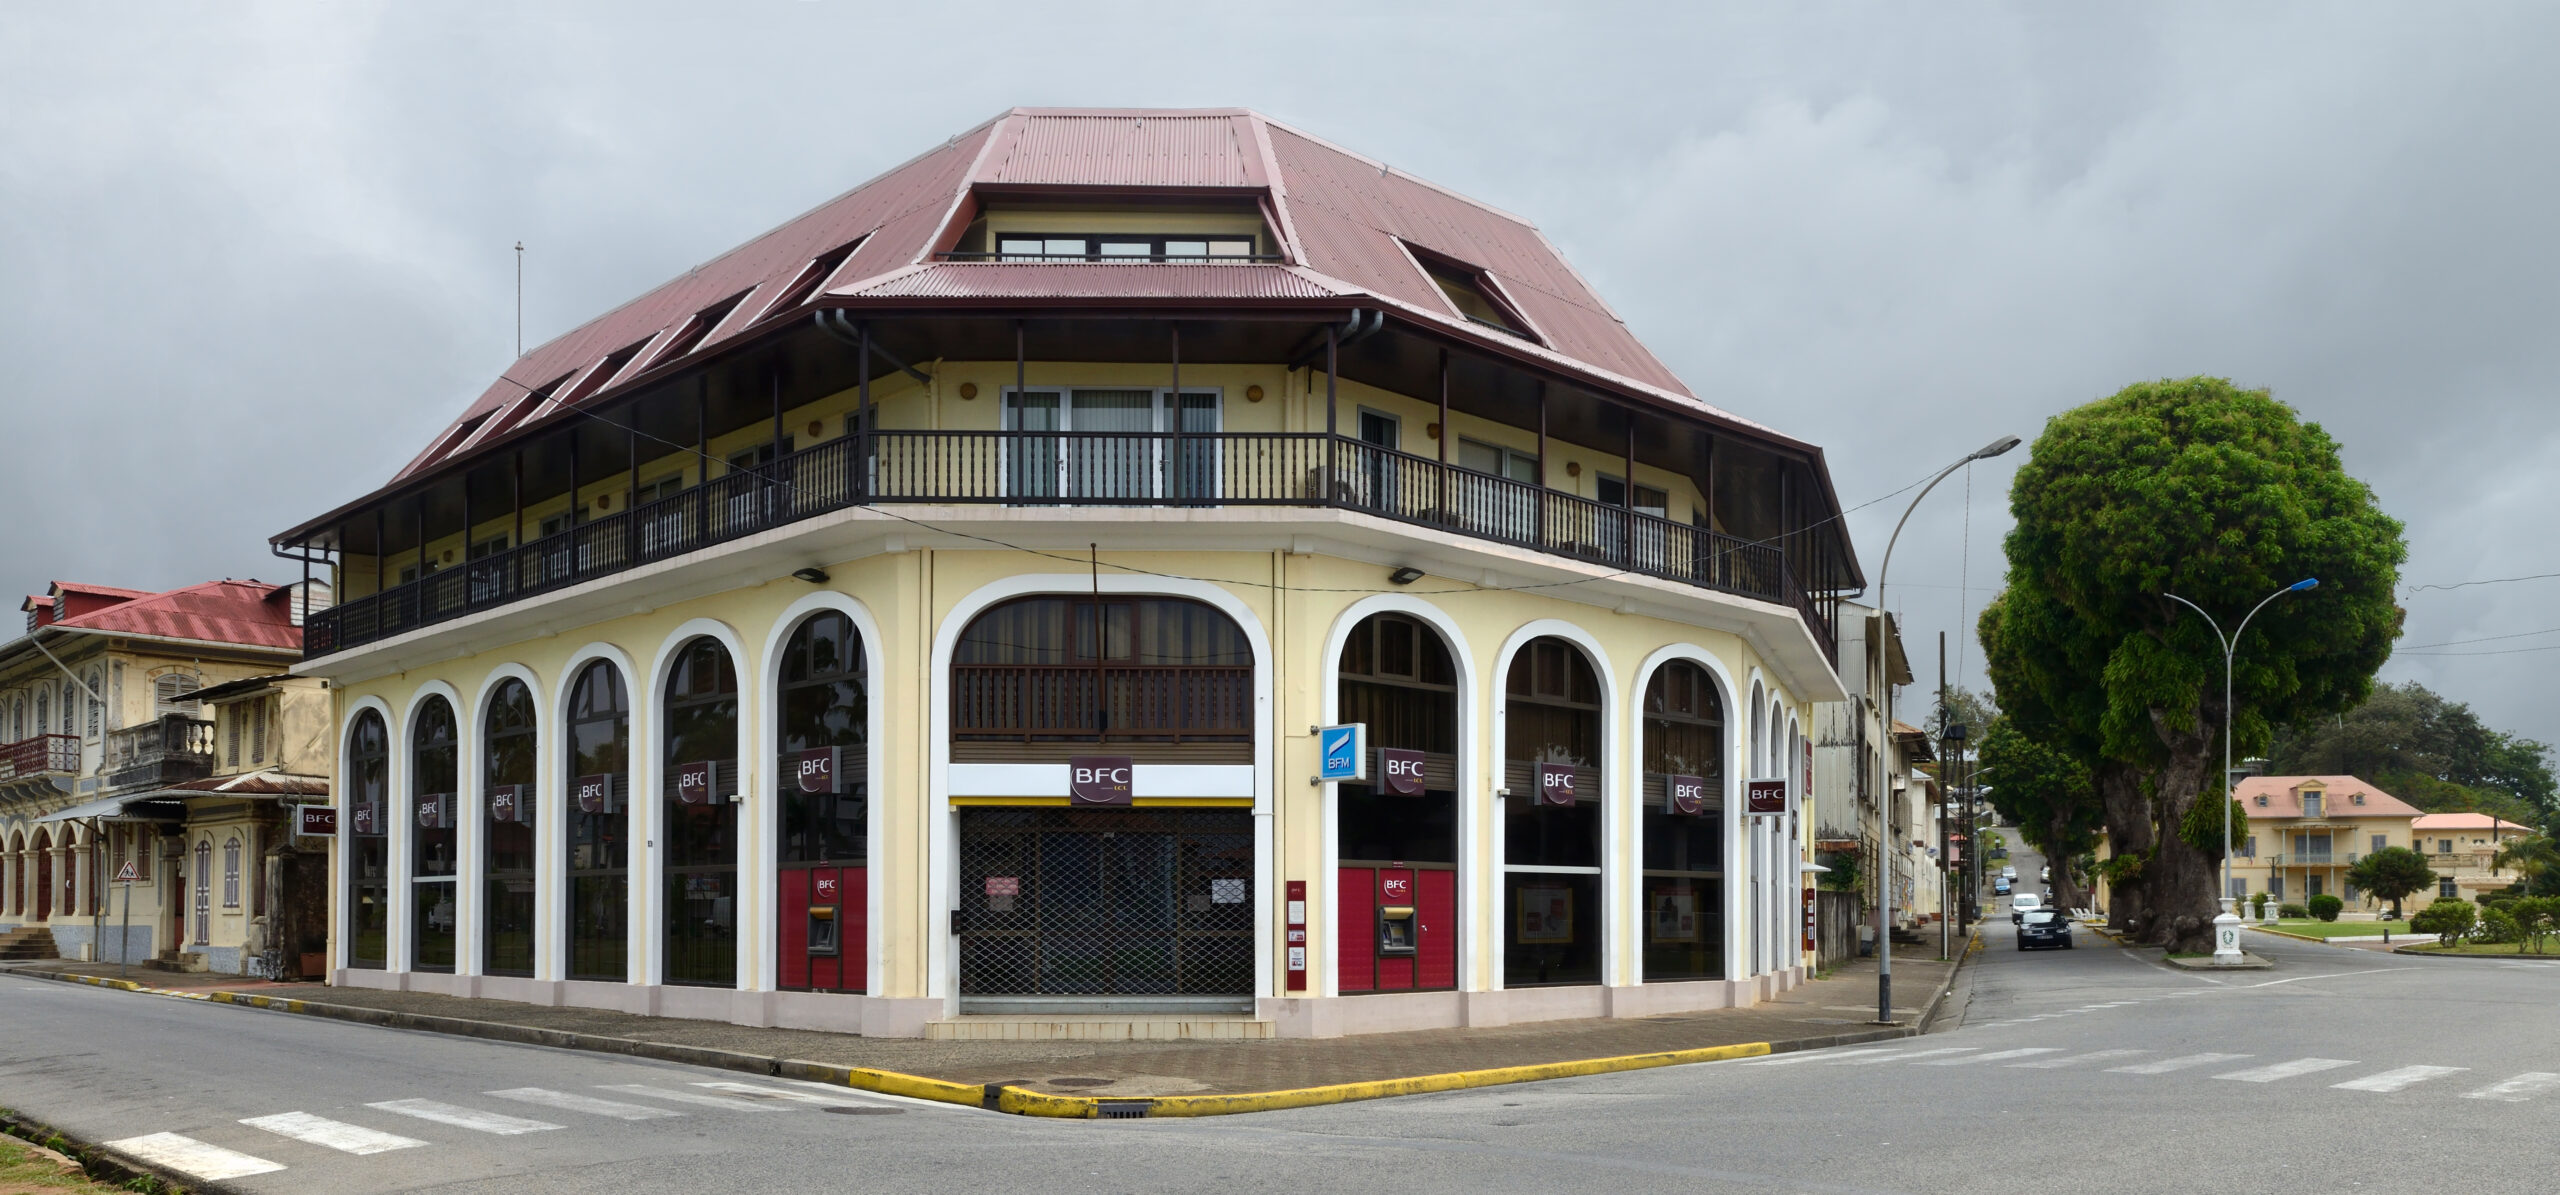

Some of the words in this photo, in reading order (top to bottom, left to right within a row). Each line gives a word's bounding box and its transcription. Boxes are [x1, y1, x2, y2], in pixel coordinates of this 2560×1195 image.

[802, 758, 830, 775] BFC
[1328, 757, 1350, 769] BFM
[1388, 760, 1424, 777] BFC
[683, 772, 706, 787] BFC
[1076, 768, 1129, 784] BFC
[1545, 773, 1574, 788] BFC
[582, 784, 602, 798] BFC
[1677, 785, 1702, 799] BFC
[1752, 789, 1784, 799] BFC
[496, 794, 513, 806] BFC
[422, 802, 437, 814] BFC
[305, 814, 335, 824] BFC
[357, 809, 371, 821] BFC
[819, 880, 836, 889] BFC
[1386, 880, 1407, 889] BFC
